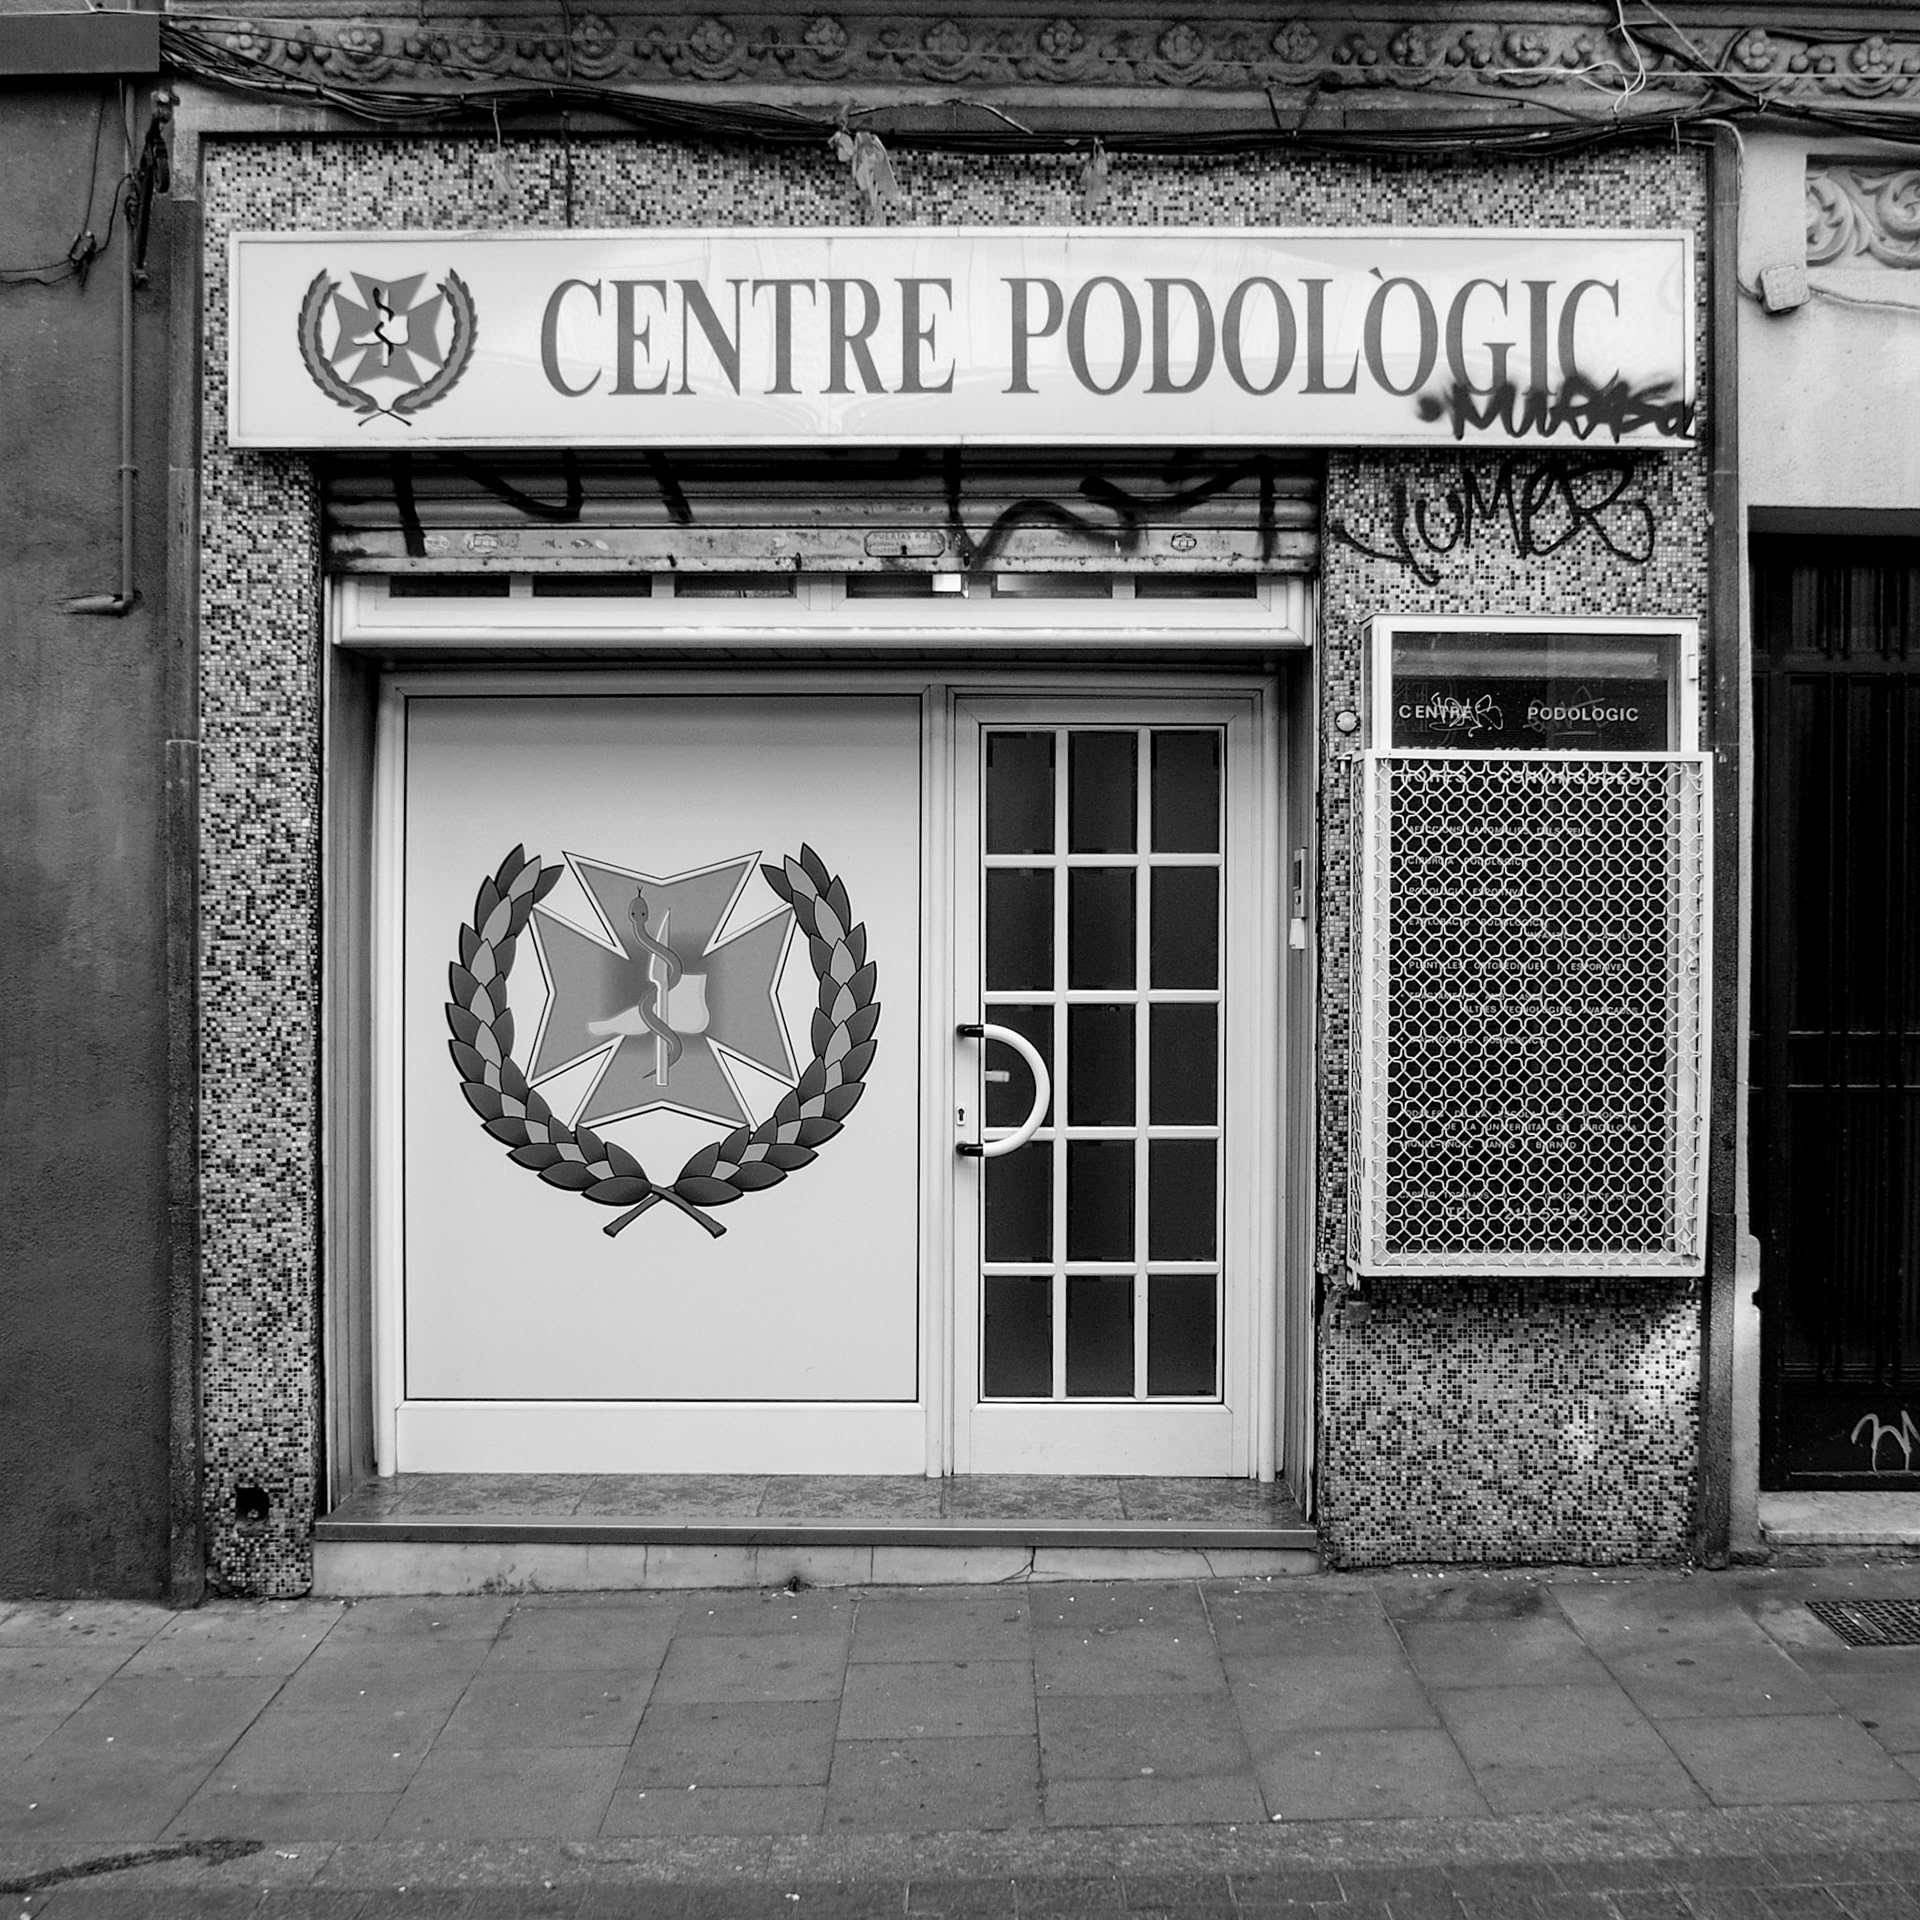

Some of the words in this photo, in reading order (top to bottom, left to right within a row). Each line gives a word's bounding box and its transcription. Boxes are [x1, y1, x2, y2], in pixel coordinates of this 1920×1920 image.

[540, 277, 956, 398] CENTRE
[1000, 266, 1620, 397] PODOLÒGIC
[1398, 705, 1472, 719] CENTRE
[1528, 707, 1639, 721] PODOLOGIC
[1408, 826, 1462, 834] AFCCIONS
[1474, 826, 1530, 835] ANOMLIES
[1536, 827, 1561, 835] DLS
[1408, 857, 1454, 865] CIRURGA
[1409, 962, 1463, 970] PLNTLLES
[1473, 962, 1546, 971] OTOEDIUE
[1571, 962, 1628, 971] ESPORIVE
[1465, 1005, 1497, 1014] ALTES
[1498, 1110, 1537, 1118] ESCOL
[1486, 1123, 1546, 1132] UNVERITA
[1579, 1124, 1638, 1133] BRCELONA
[1535, 1141, 1577, 1149] BRND
[1578, 1192, 1638, 1201] ARCELOA
